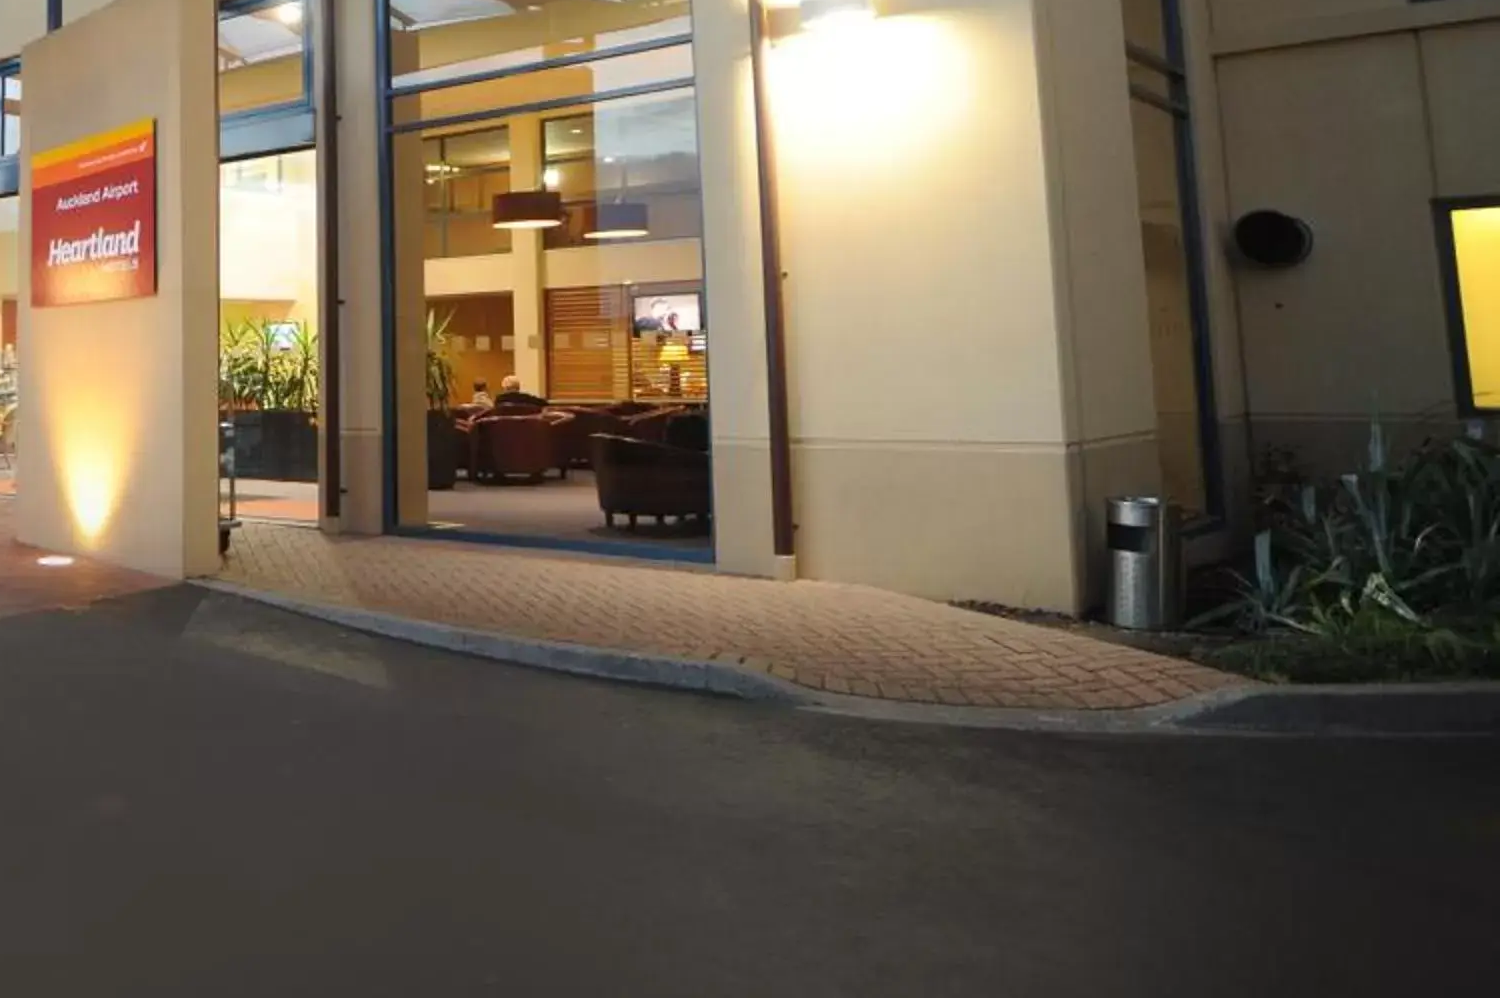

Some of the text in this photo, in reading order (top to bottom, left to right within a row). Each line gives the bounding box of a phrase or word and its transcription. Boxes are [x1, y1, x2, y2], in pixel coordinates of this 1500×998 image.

[57, 178, 139, 211] Auckland Airport
[48, 220, 140, 266] Heartland
